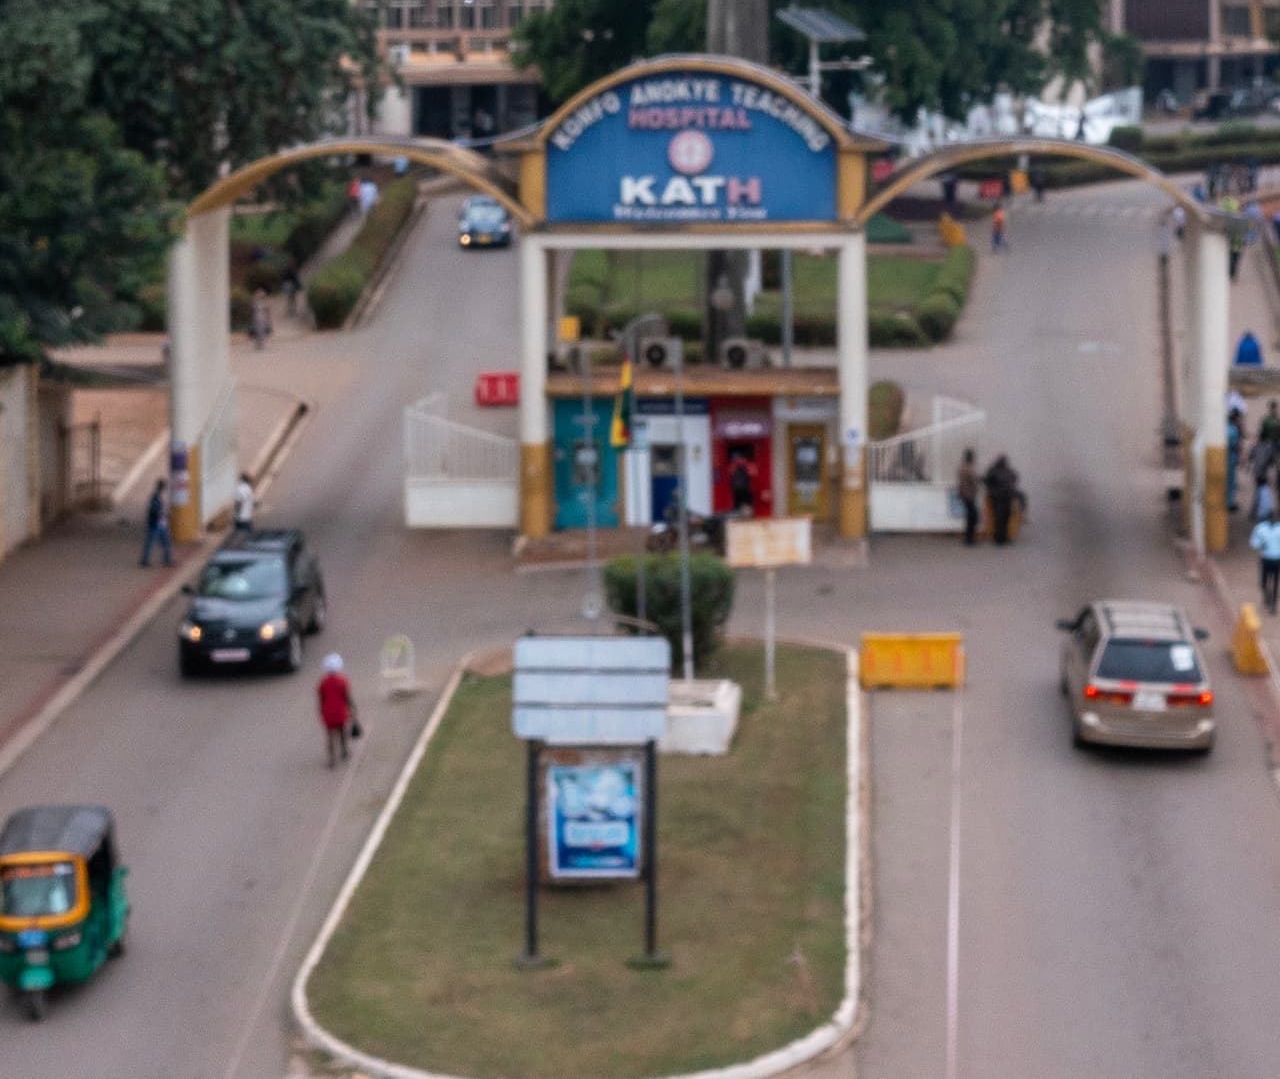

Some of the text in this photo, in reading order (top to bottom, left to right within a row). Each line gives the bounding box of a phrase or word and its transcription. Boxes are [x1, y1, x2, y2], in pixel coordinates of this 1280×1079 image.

[550, 78, 830, 152] KOMFO ANOKYE TEACHING
[628, 107, 753, 130] HOSPITAL
[620, 176, 762, 206] KATH
